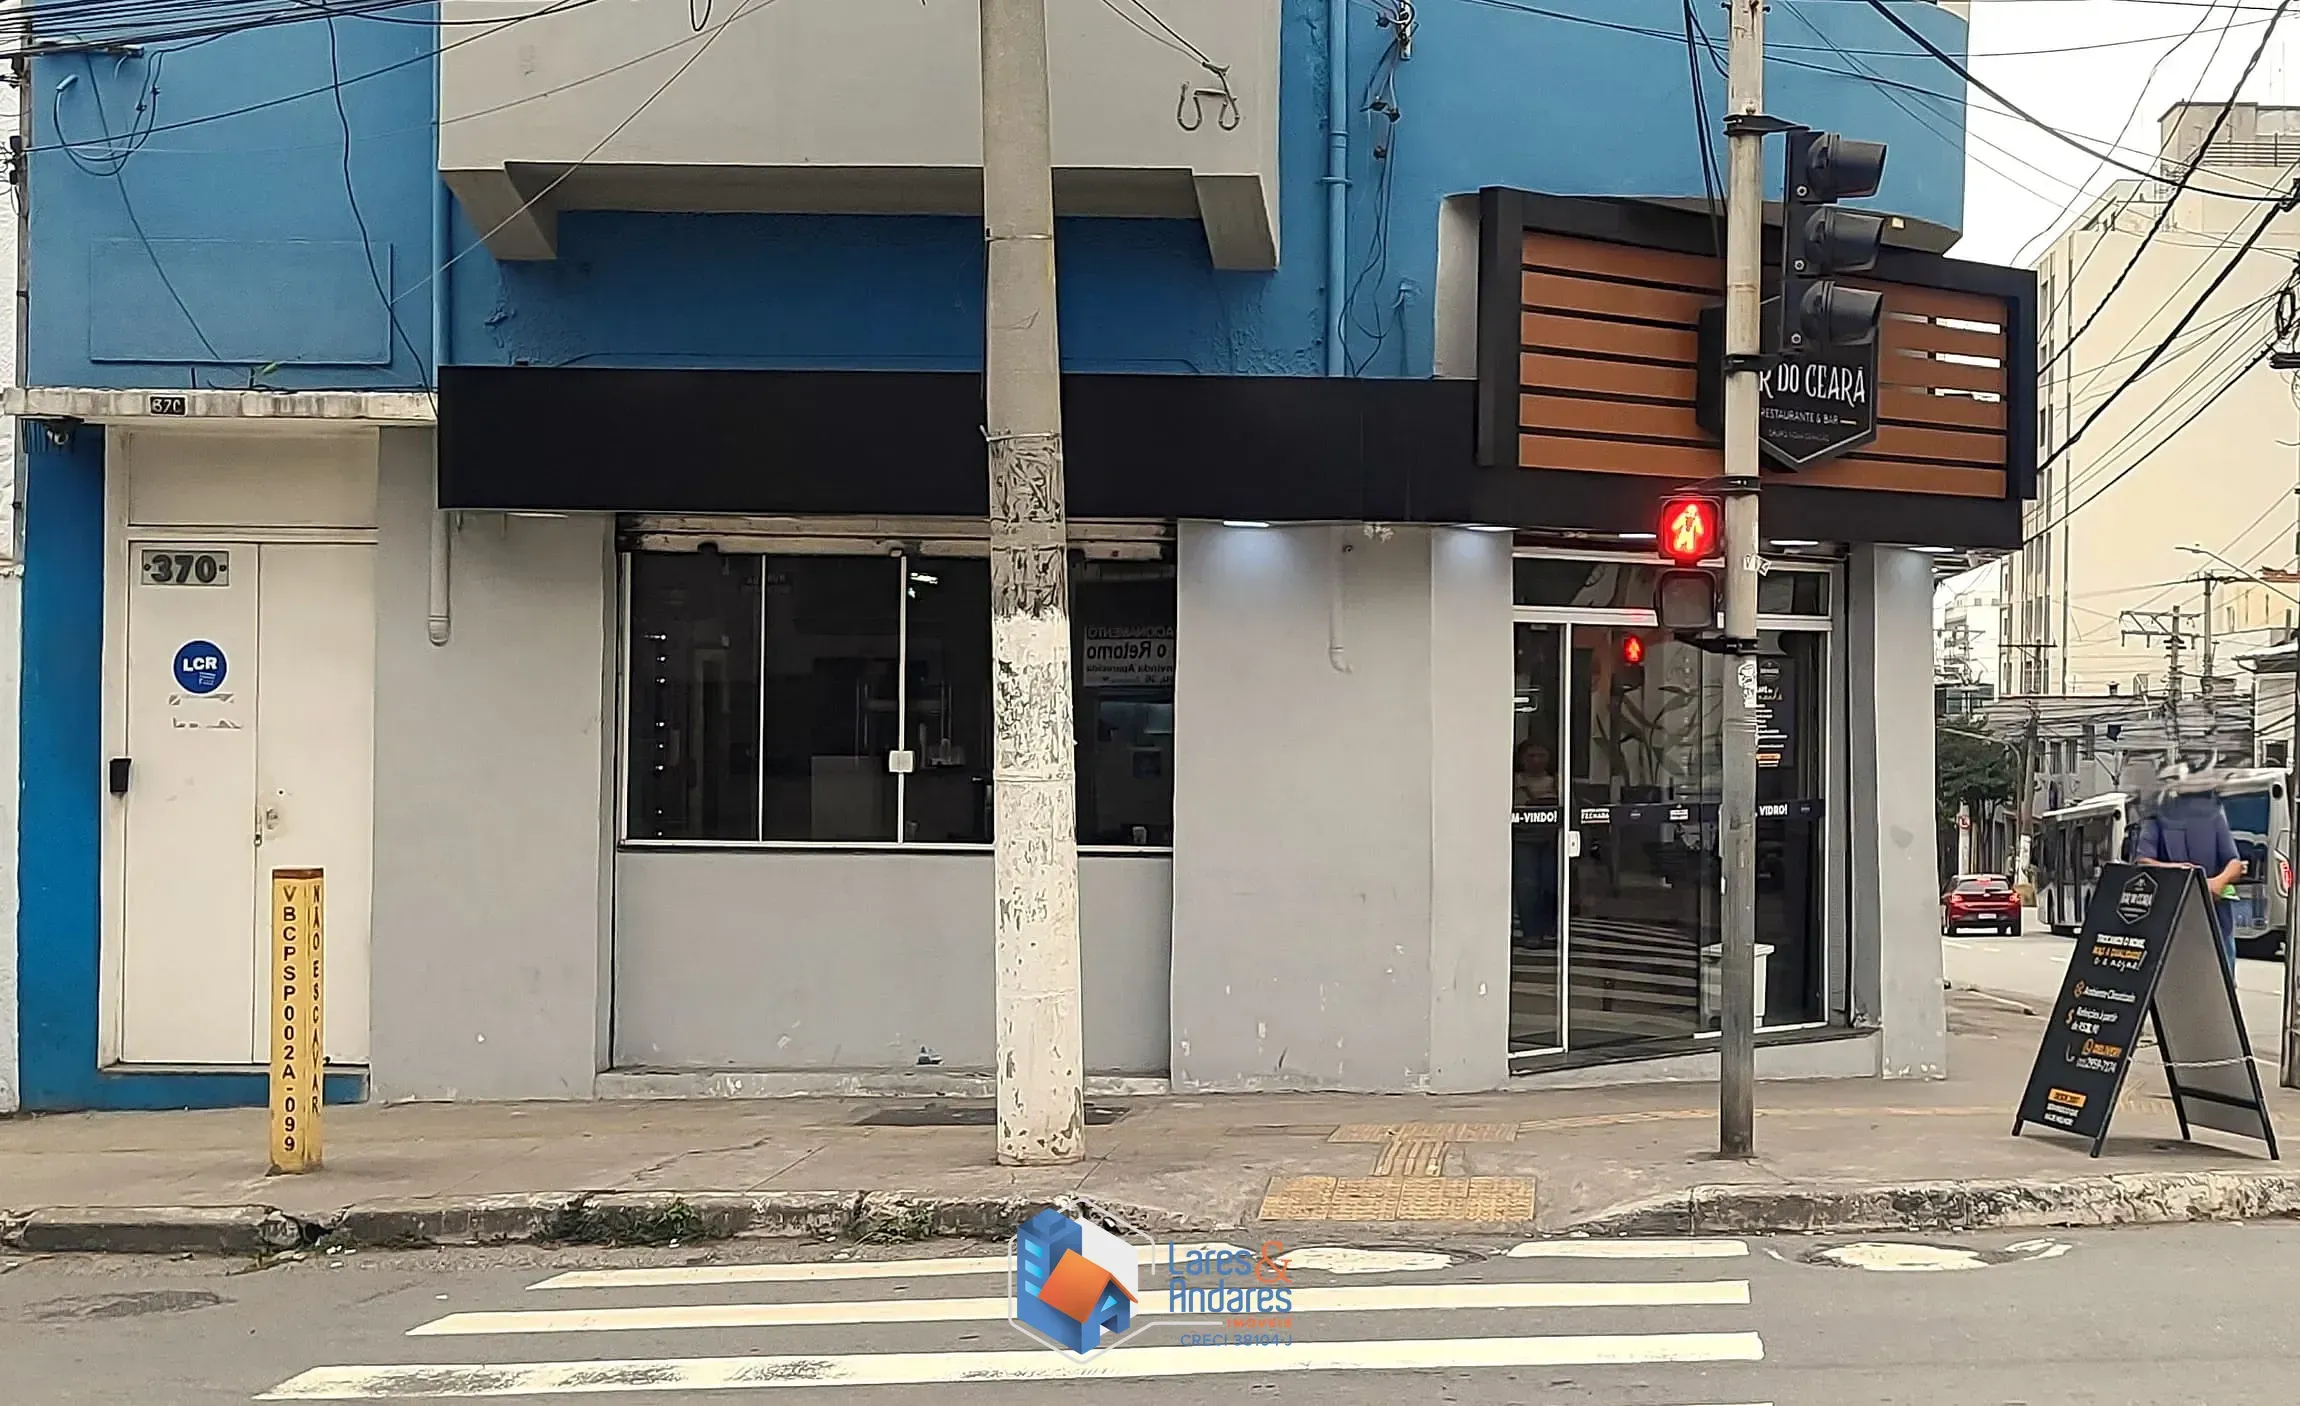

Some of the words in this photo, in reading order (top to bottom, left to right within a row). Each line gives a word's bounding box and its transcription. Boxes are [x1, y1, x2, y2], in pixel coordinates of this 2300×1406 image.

[1777, 363, 1800, 393] DO
[1805, 364, 1865, 408] CEARÁ
[1760, 407, 1815, 423] RESTAURANTE
[1823, 413, 1839, 424] BAR
[150, 554, 217, 583] 370
[183, 656, 217, 672] LCR
[1511, 811, 1558, 823] M-VINDO!
[1759, 803, 1788, 816] VIDRO!
[312, 959, 321, 1115] ESCAVAR
